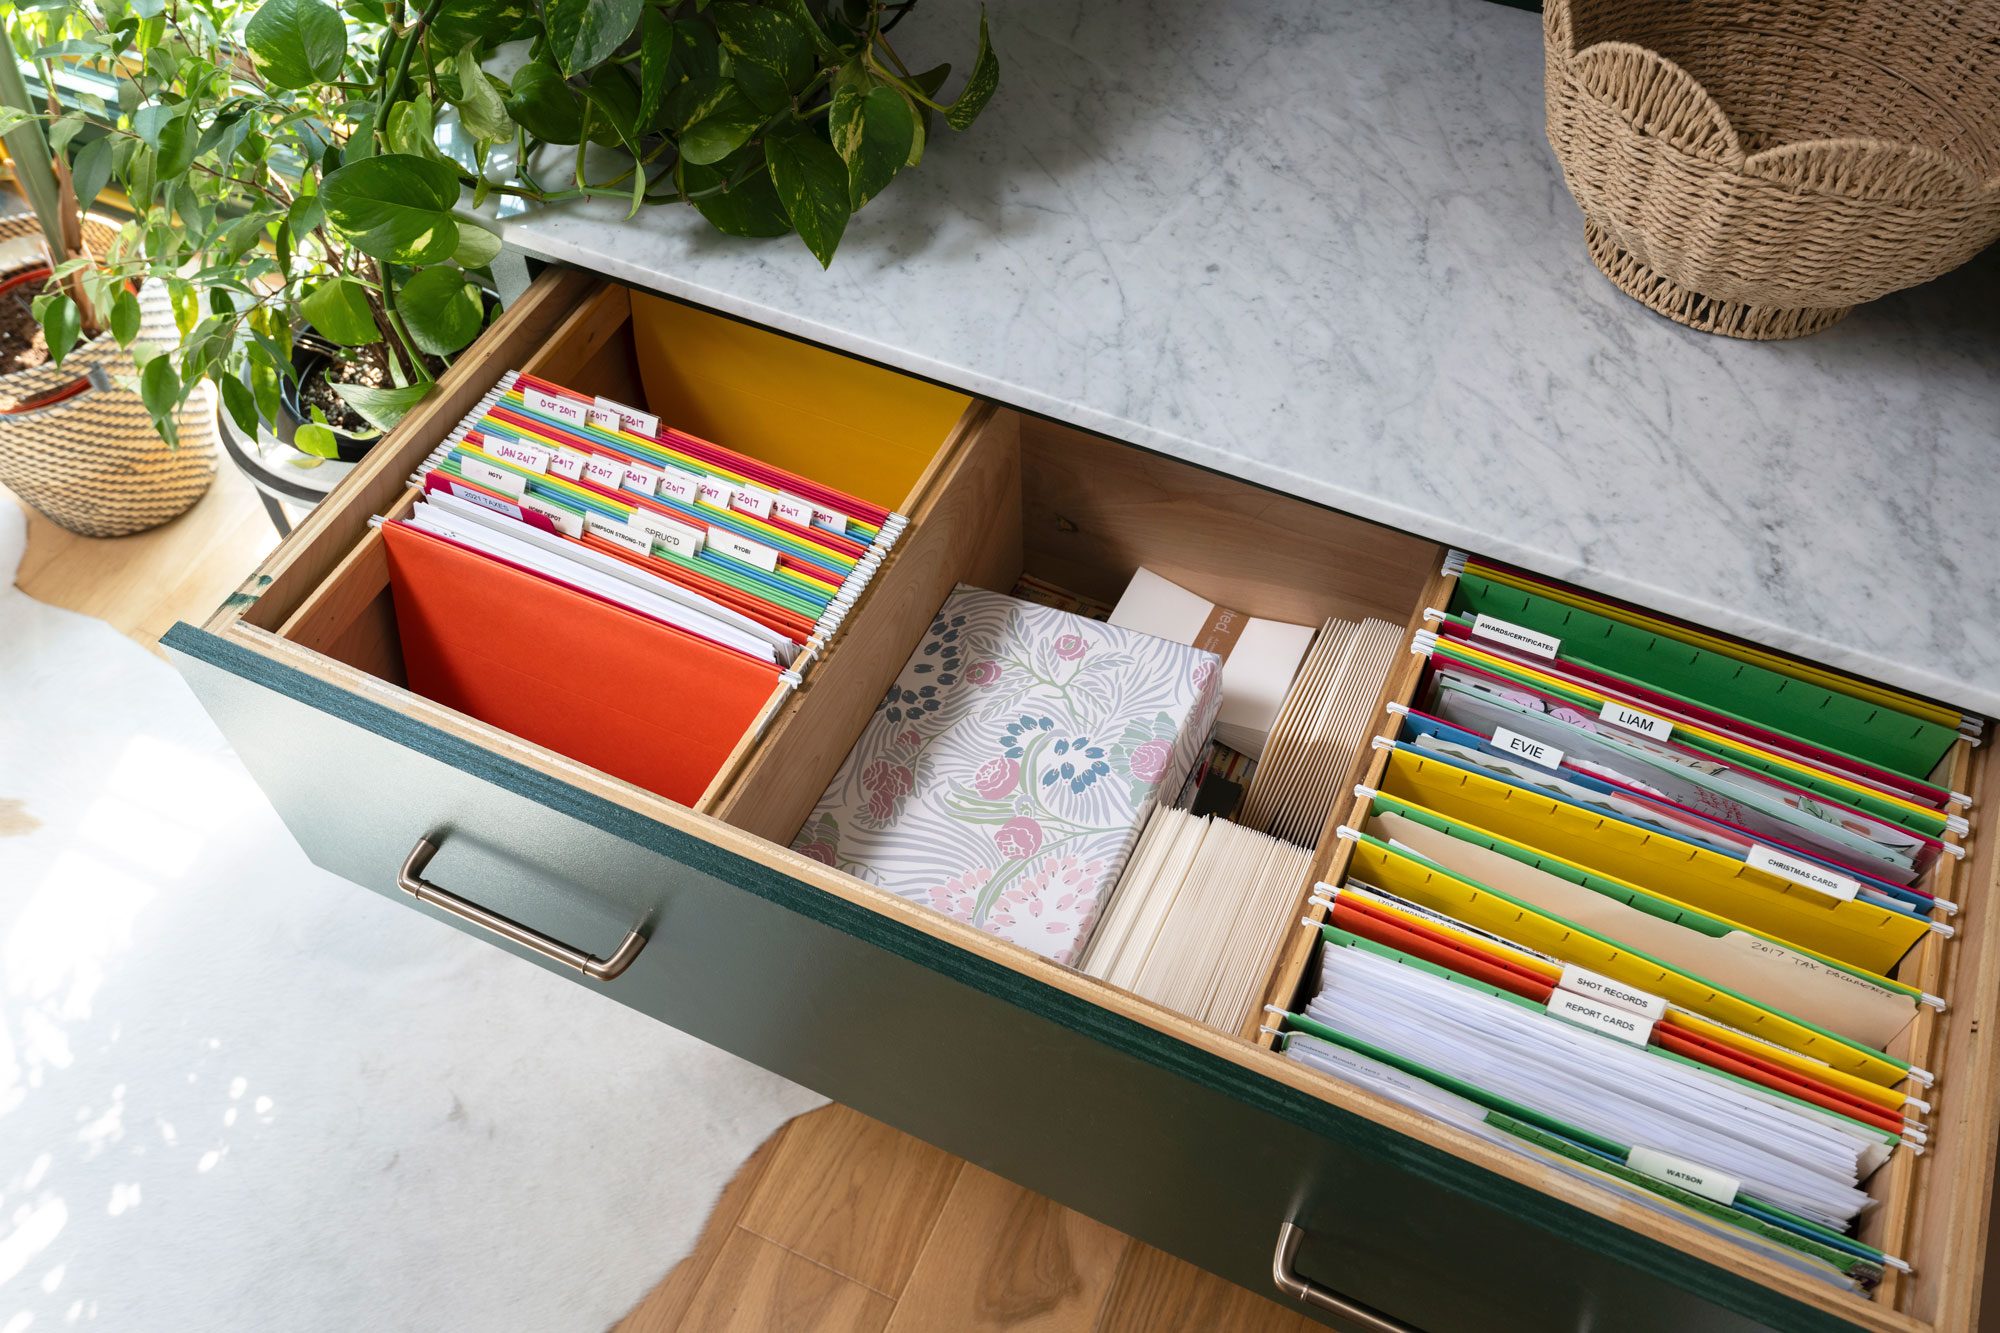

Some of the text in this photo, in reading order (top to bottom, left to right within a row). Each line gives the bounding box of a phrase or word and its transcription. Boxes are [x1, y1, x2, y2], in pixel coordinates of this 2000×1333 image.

[540, 399, 577, 418] OCT 2017
[590, 410, 608, 422] 2017
[625, 415, 645, 428] 2017
[497, 446, 537, 465] JAN 2017
[552, 455, 574, 470] 2017
[488, 471, 502, 480] HGTV
[591, 465, 613, 479] 2017
[626, 470, 648, 485] 2017
[665, 481, 685, 495] 2017
[700, 484, 719, 499] 2017
[464, 491, 510, 512] 2021 TAXES
[738, 493, 759, 509] 2017
[544, 511, 562, 522] DEPOT
[780, 504, 799, 517] 2017
[812, 510, 833, 523] 2017
[591, 521, 647, 549] SIMPSON STRONG-TIE
[645, 527, 680, 546] SPRUC'D
[733, 544, 751, 555] RYOBI
[1480, 622, 1554, 651] AWARDS/CERTIFICATES
[1618, 711, 1655, 731] LIAM
[1510, 737, 1544, 759] EVIE
[1767, 858, 1838, 890] CHRISTMAS CARDS
[1751, 941, 1785, 957] 2017
[1791, 956, 1820, 970] TAX
[1577, 977, 1649, 1008] SHOT RECORDS
[1565, 1001, 1635, 1031] REPORT CARDS
[1666, 1168, 1703, 1185] WATSON
